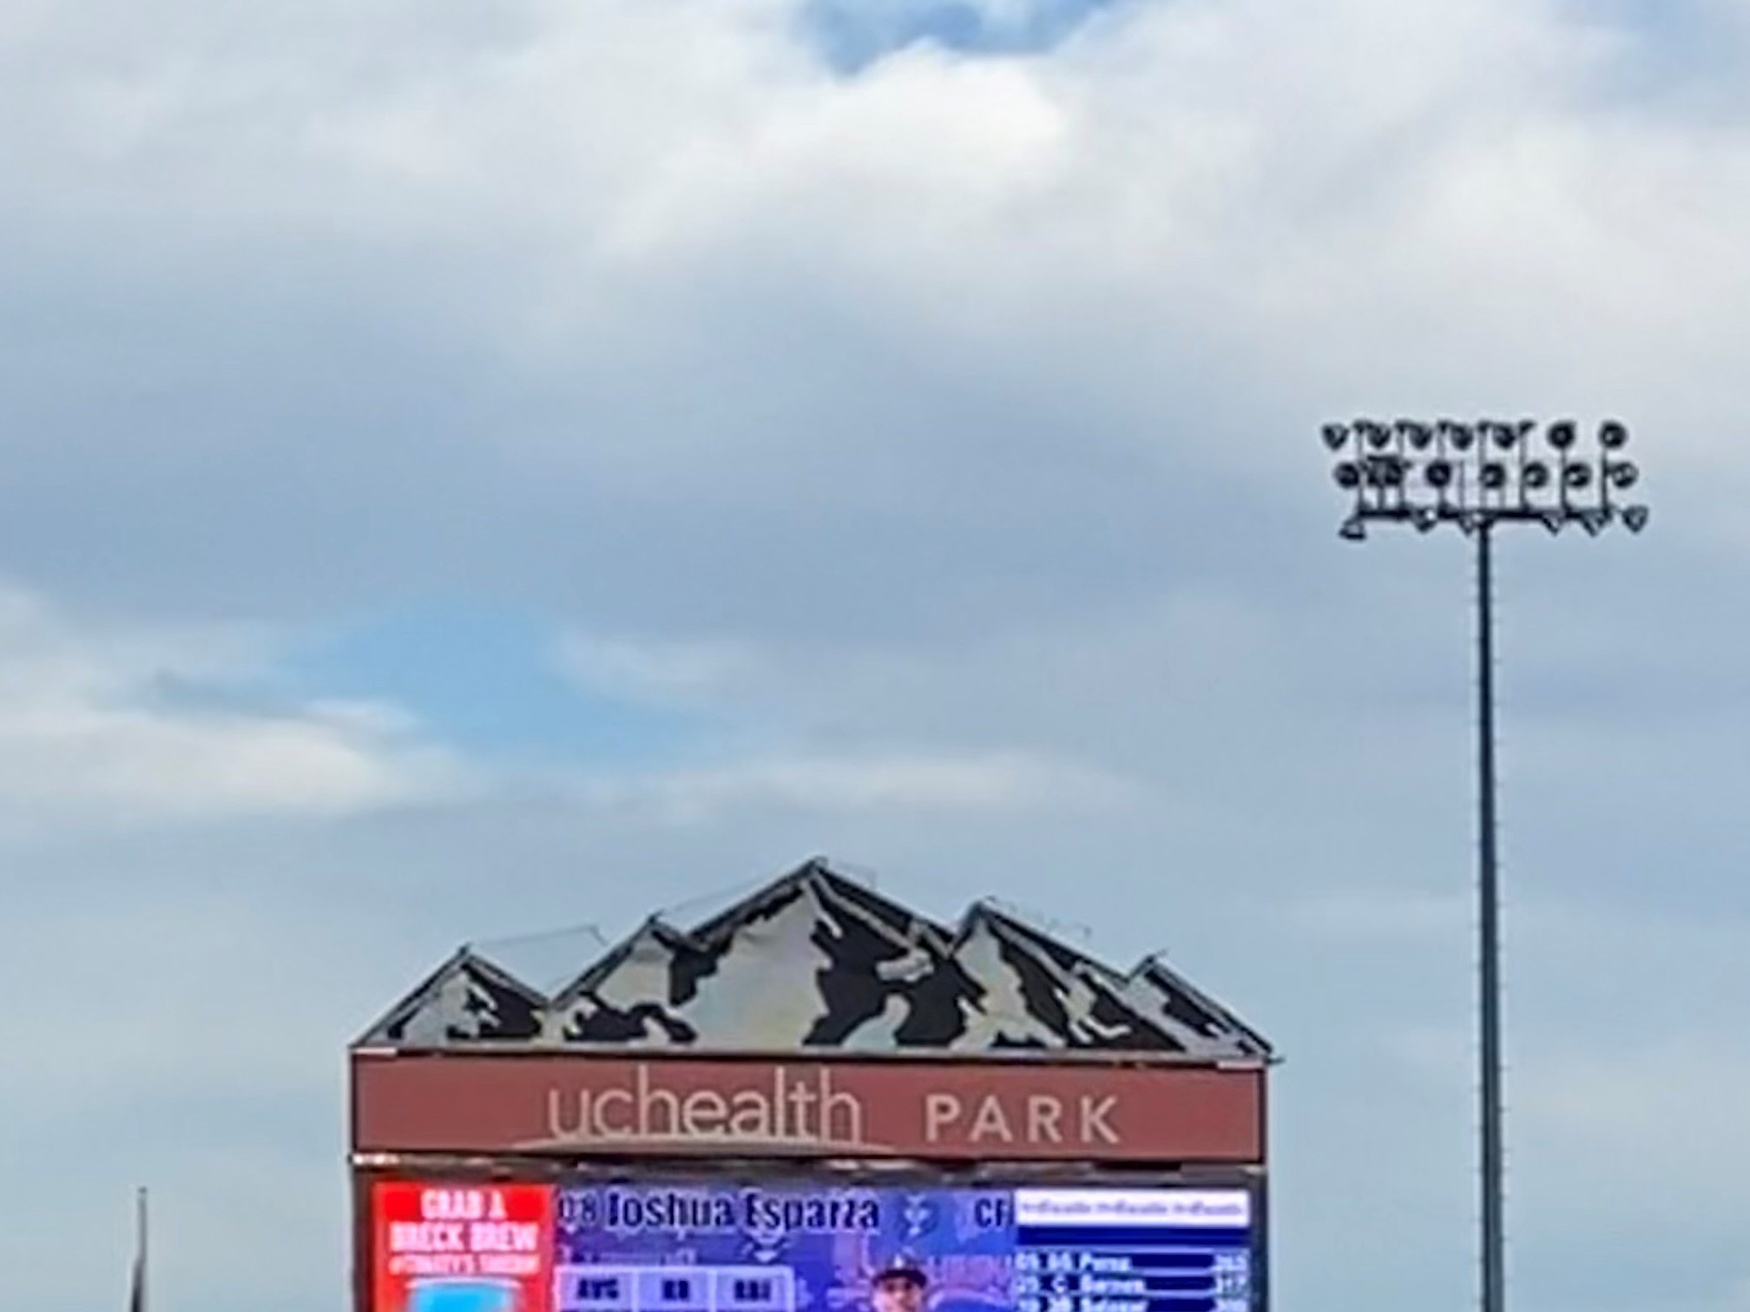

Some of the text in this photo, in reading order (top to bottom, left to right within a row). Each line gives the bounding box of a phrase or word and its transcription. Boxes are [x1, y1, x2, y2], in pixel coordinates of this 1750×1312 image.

[548, 1064, 1120, 1144] uchealth PARK
[420, 1189, 508, 1220] GRAB A
[608, 1193, 736, 1228] Joshua
[744, 1193, 880, 1231] Esparza
[389, 1221, 540, 1252] BRECK BREW
